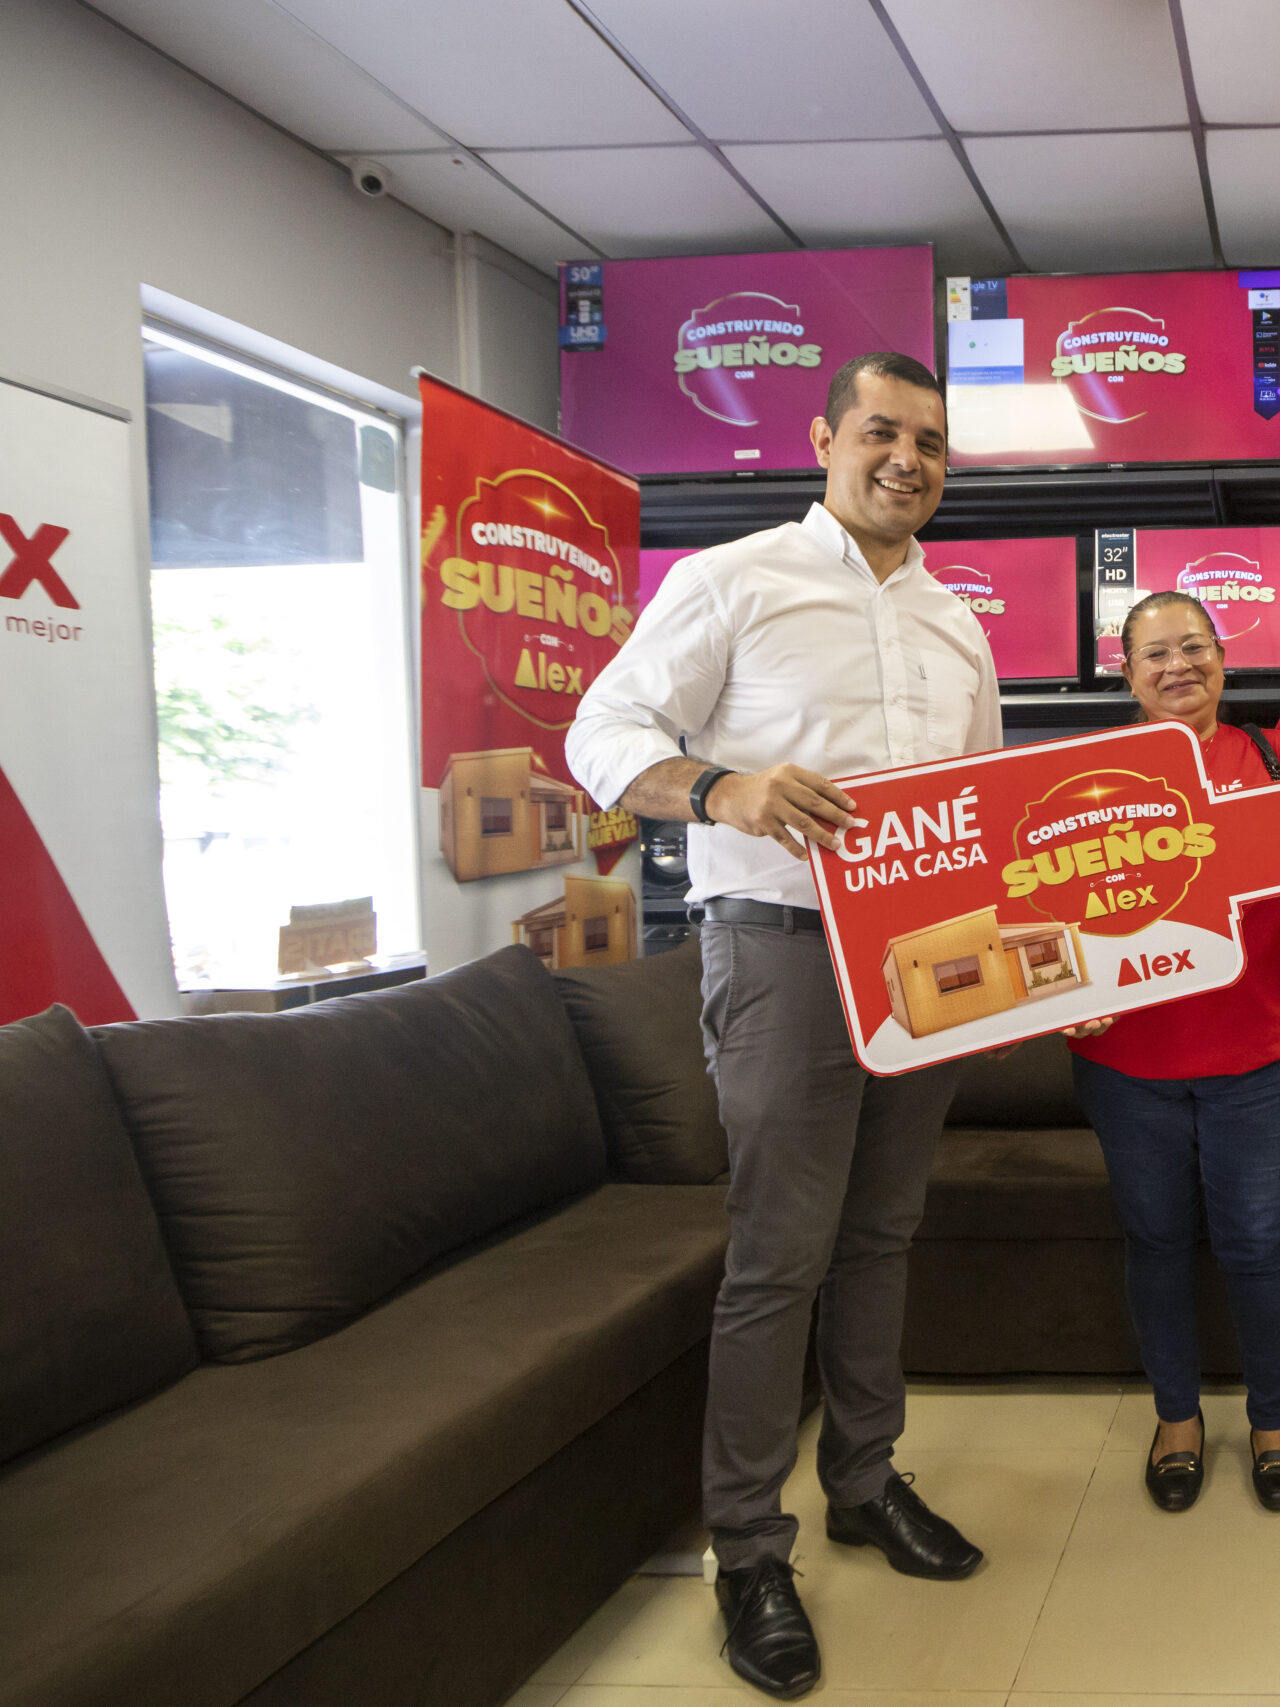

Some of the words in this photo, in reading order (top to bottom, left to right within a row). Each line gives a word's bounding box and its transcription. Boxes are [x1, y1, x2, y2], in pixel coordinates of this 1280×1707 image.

[987, 281, 998, 289] TV
[686, 319, 805, 341] CONSTRUYENDO
[1063, 331, 1169, 350] CONSTRUYENDO
[674, 335, 823, 373] SUEÑOS
[1051, 344, 1186, 378] SUEÑOS
[734, 371, 755, 380] CON
[1107, 375, 1124, 383] CON
[471, 522, 613, 586] CONSTRUYENDO
[1105, 568, 1127, 581] HD
[1183, 570, 1263, 584] CONSTRUYENDO
[440, 557, 635, 647] SUEÑOS
[1174, 581, 1276, 603] UEÑOS
[6, 615, 83, 643] mejor
[540, 634, 559, 647] CON
[514, 648, 583, 696] Alex
[588, 820, 637, 847] NUEVAS
[834, 786, 981, 863] GANÉ
[1027, 804, 1177, 845] CONSTRUYENDO
[845, 860, 909, 892] UNA
[914, 843, 988, 877] CASA
[1001, 820, 1217, 898] SUEÑOS
[1105, 873, 1125, 884] CON
[1085, 884, 1159, 920] Alex
[1117, 949, 1196, 988] Alex
